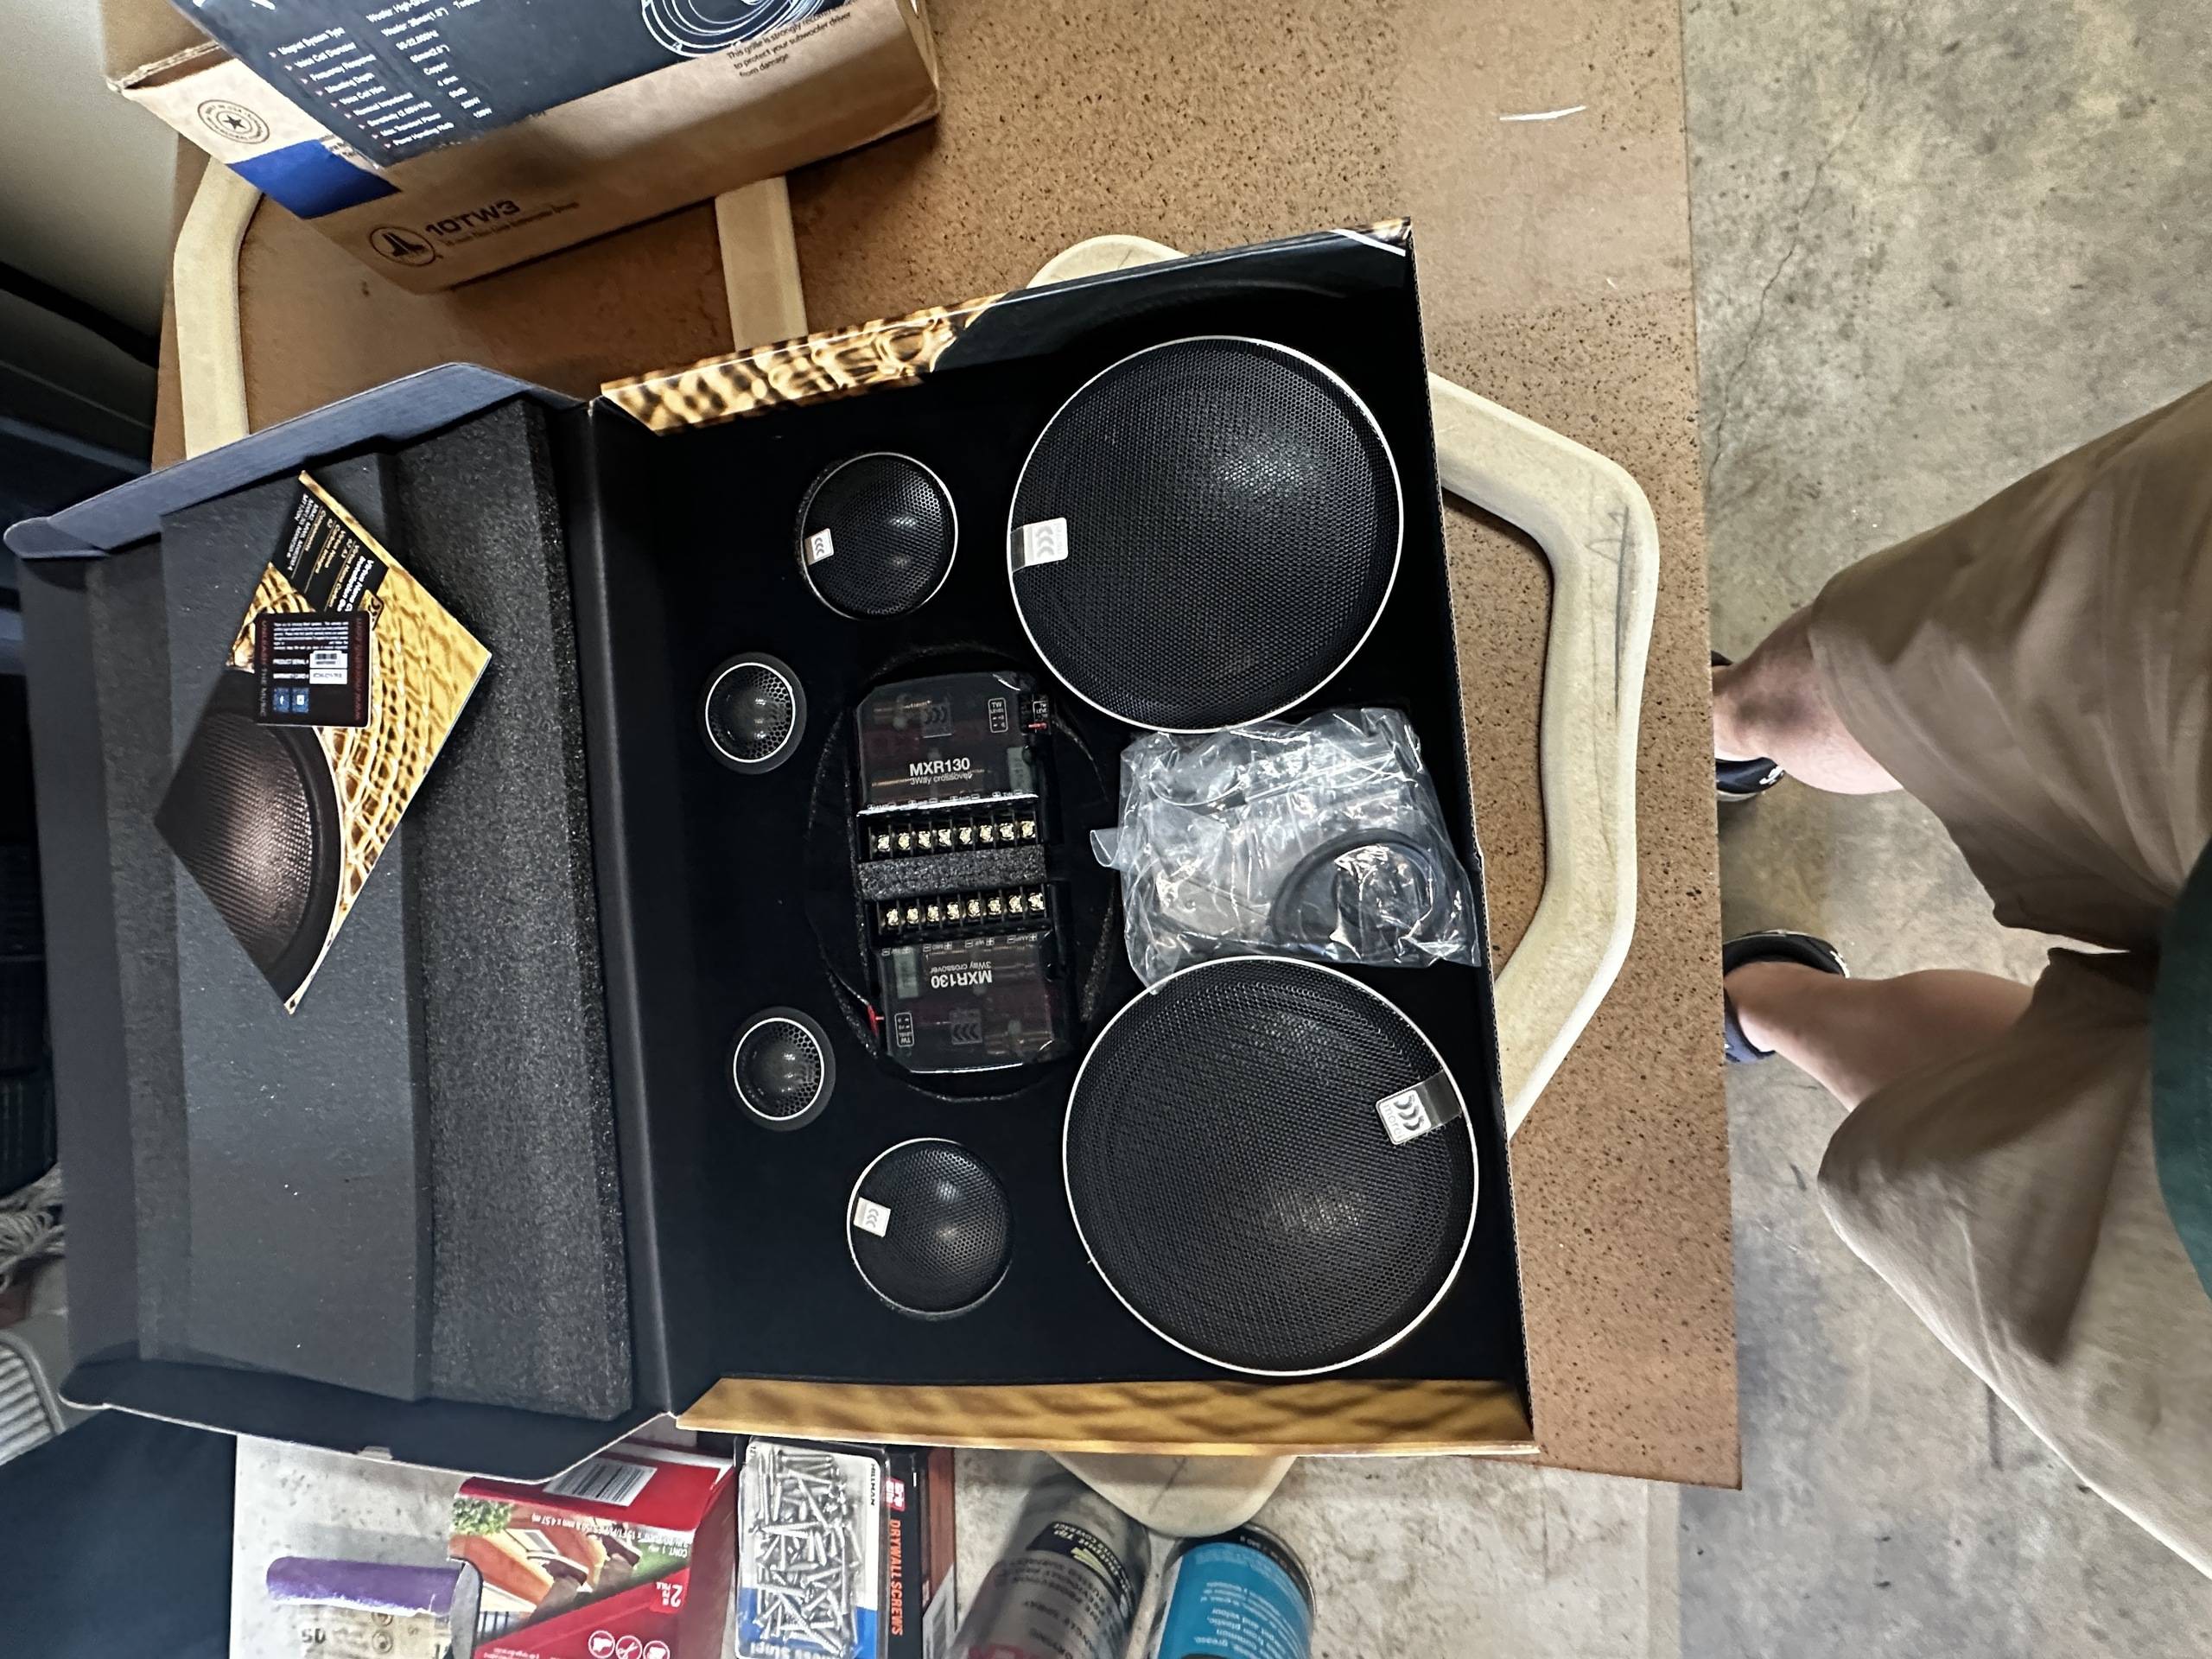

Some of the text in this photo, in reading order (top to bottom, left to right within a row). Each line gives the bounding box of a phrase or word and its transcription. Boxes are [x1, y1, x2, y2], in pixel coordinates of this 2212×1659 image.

[727, 49, 744, 60] This
[771, 22, 802, 41] strongly
[744, 49, 771, 67] protect
[772, 41, 788, 54] your
[830, 12, 851, 26] driver
[739, 54, 789, 77] from damage
[425, 200, 520, 236] 10TW3
[908, 756, 970, 777] MXR130
[929, 959, 991, 975] 3Way crossover
[930, 969, 992, 988] MXR130
[889, 1519, 903, 1637] DRYWALL SCREWS
[670, 1584, 683, 1607] 2
